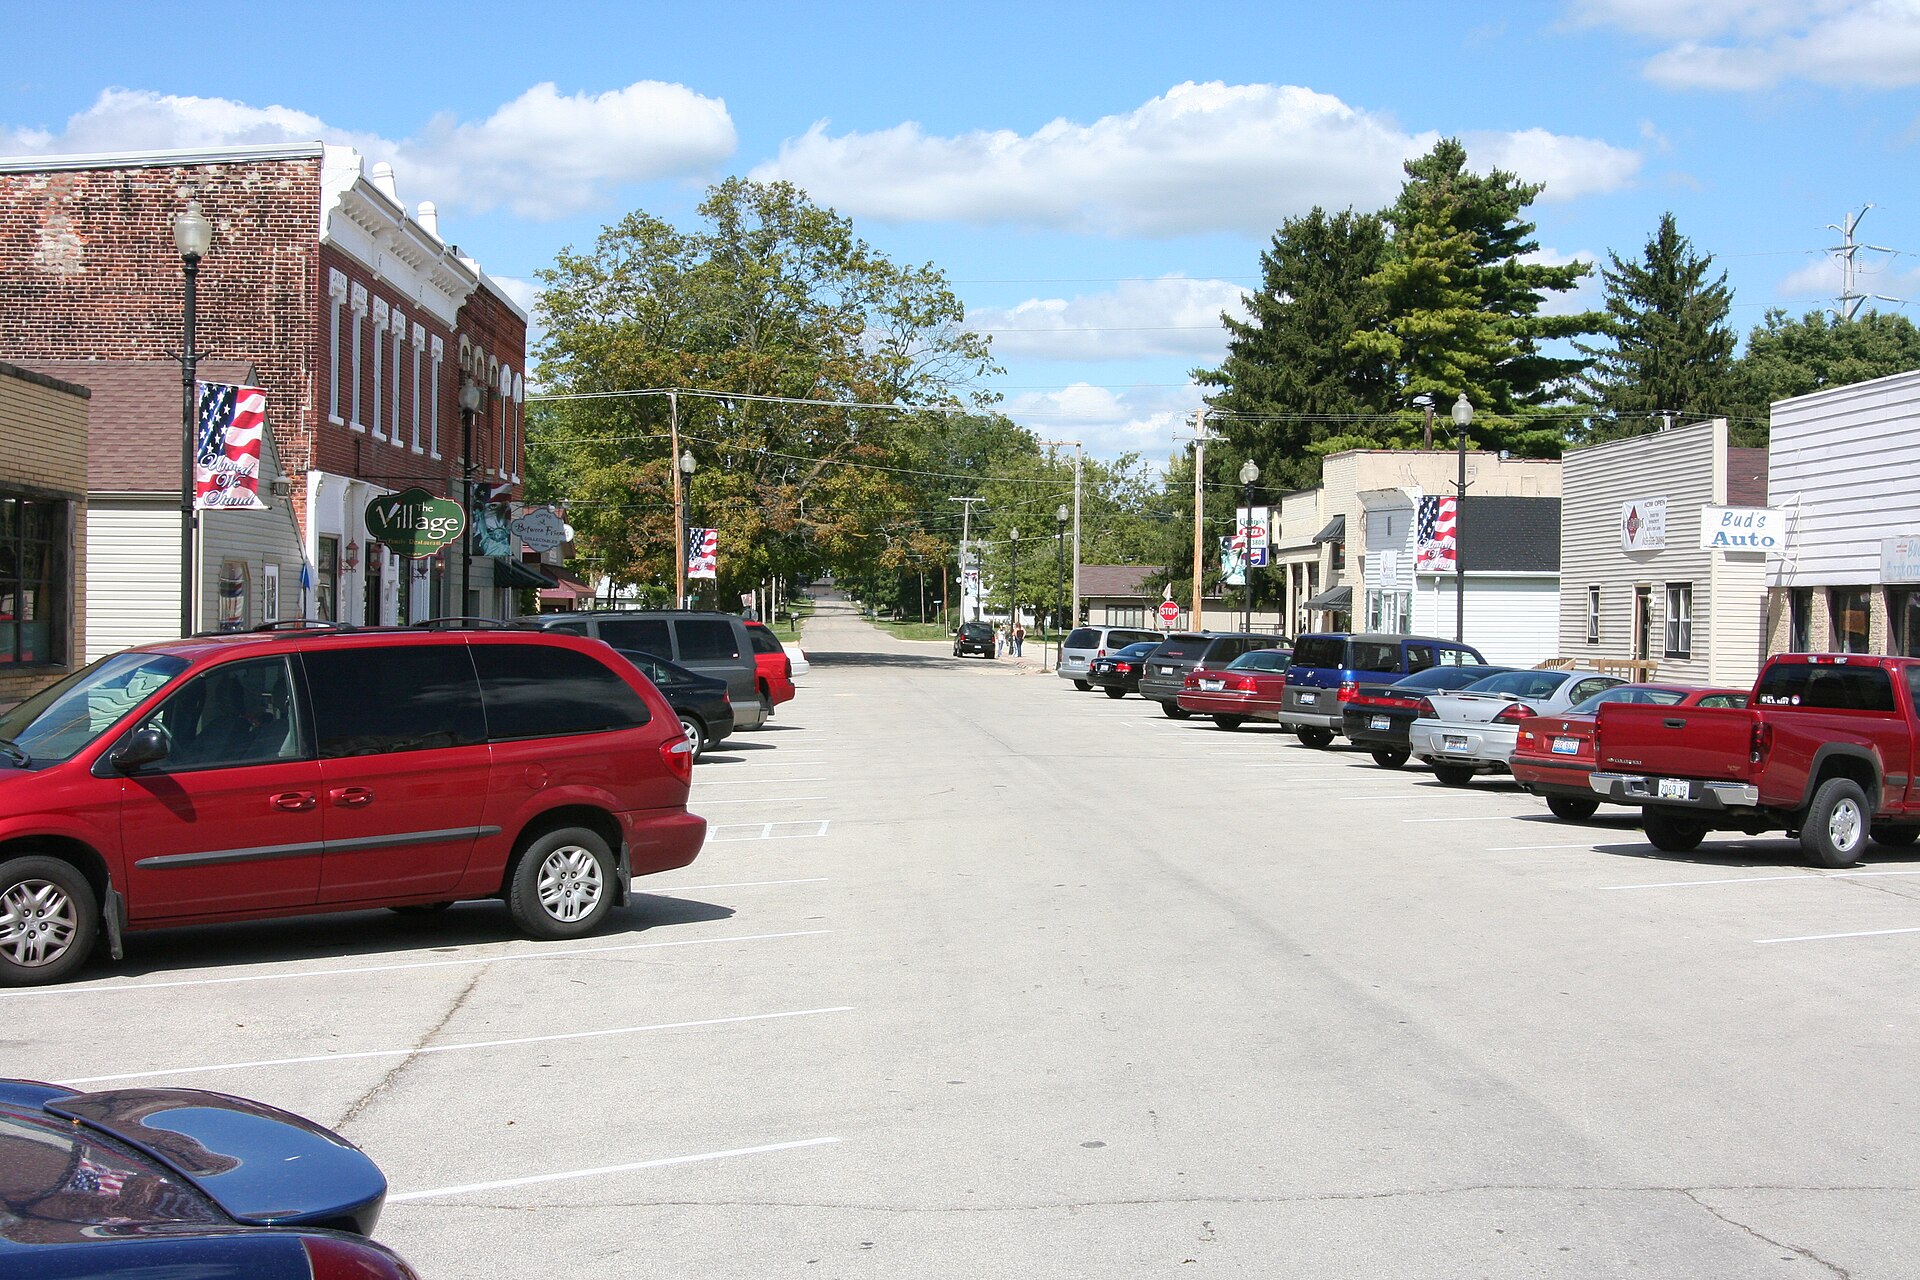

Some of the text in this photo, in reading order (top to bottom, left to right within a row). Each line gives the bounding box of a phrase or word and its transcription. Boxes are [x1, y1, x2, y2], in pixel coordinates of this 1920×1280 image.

[200, 453, 255, 476] United
[216, 473, 246, 488] We
[204, 489, 255, 506] Stand
[416, 502, 434, 512] The
[376, 501, 459, 539] Village
[1721, 511, 1767, 528] Bud's
[1711, 531, 1775, 547] Auto
[1160, 607, 1178, 616] STOP
